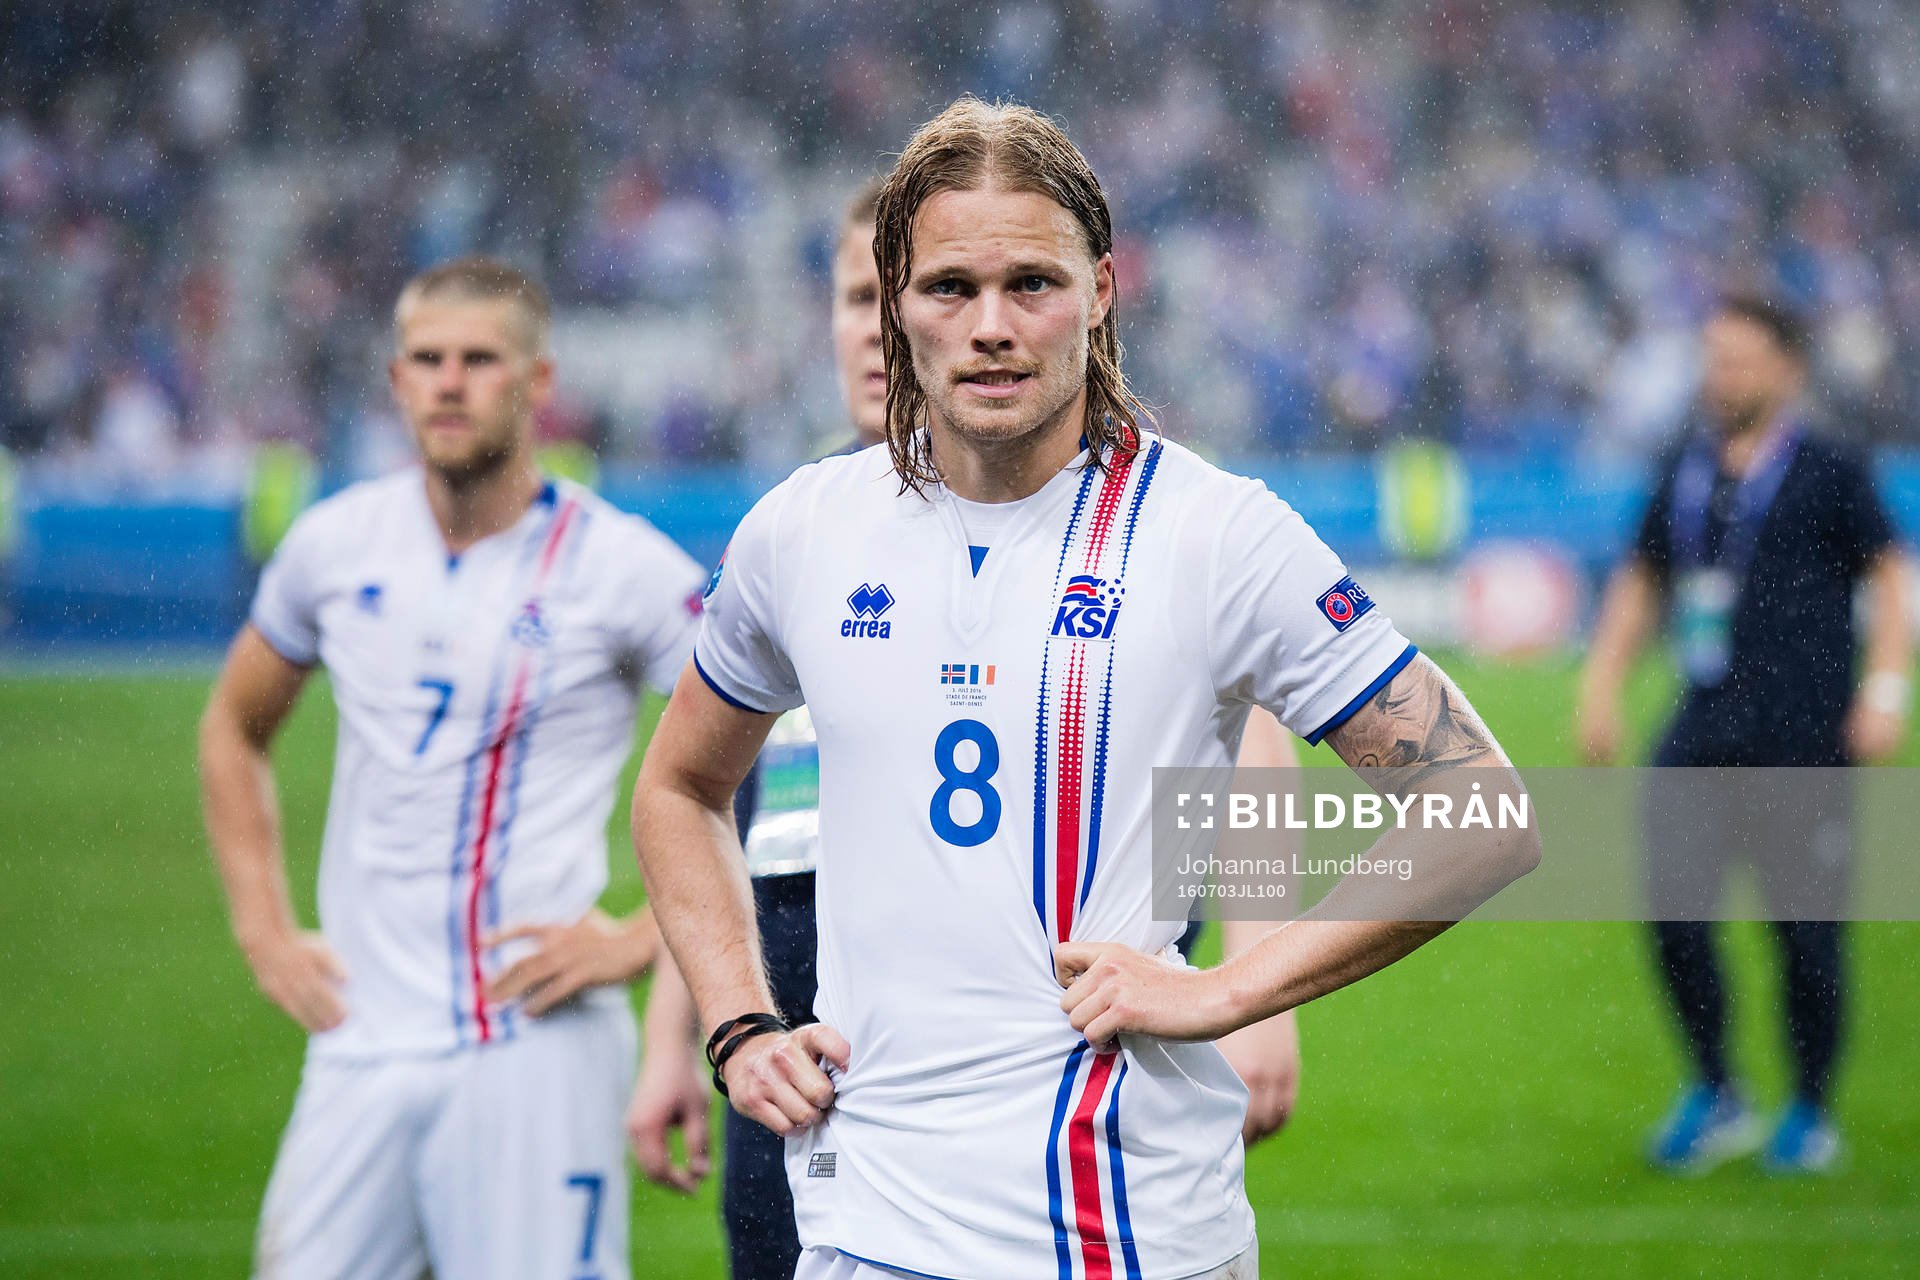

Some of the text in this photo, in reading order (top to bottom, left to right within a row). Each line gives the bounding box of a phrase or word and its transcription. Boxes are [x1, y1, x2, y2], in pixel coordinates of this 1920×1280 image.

[415, 677, 454, 756] 7
[929, 718, 1002, 848] 8
[566, 1174, 603, 1262] 7
